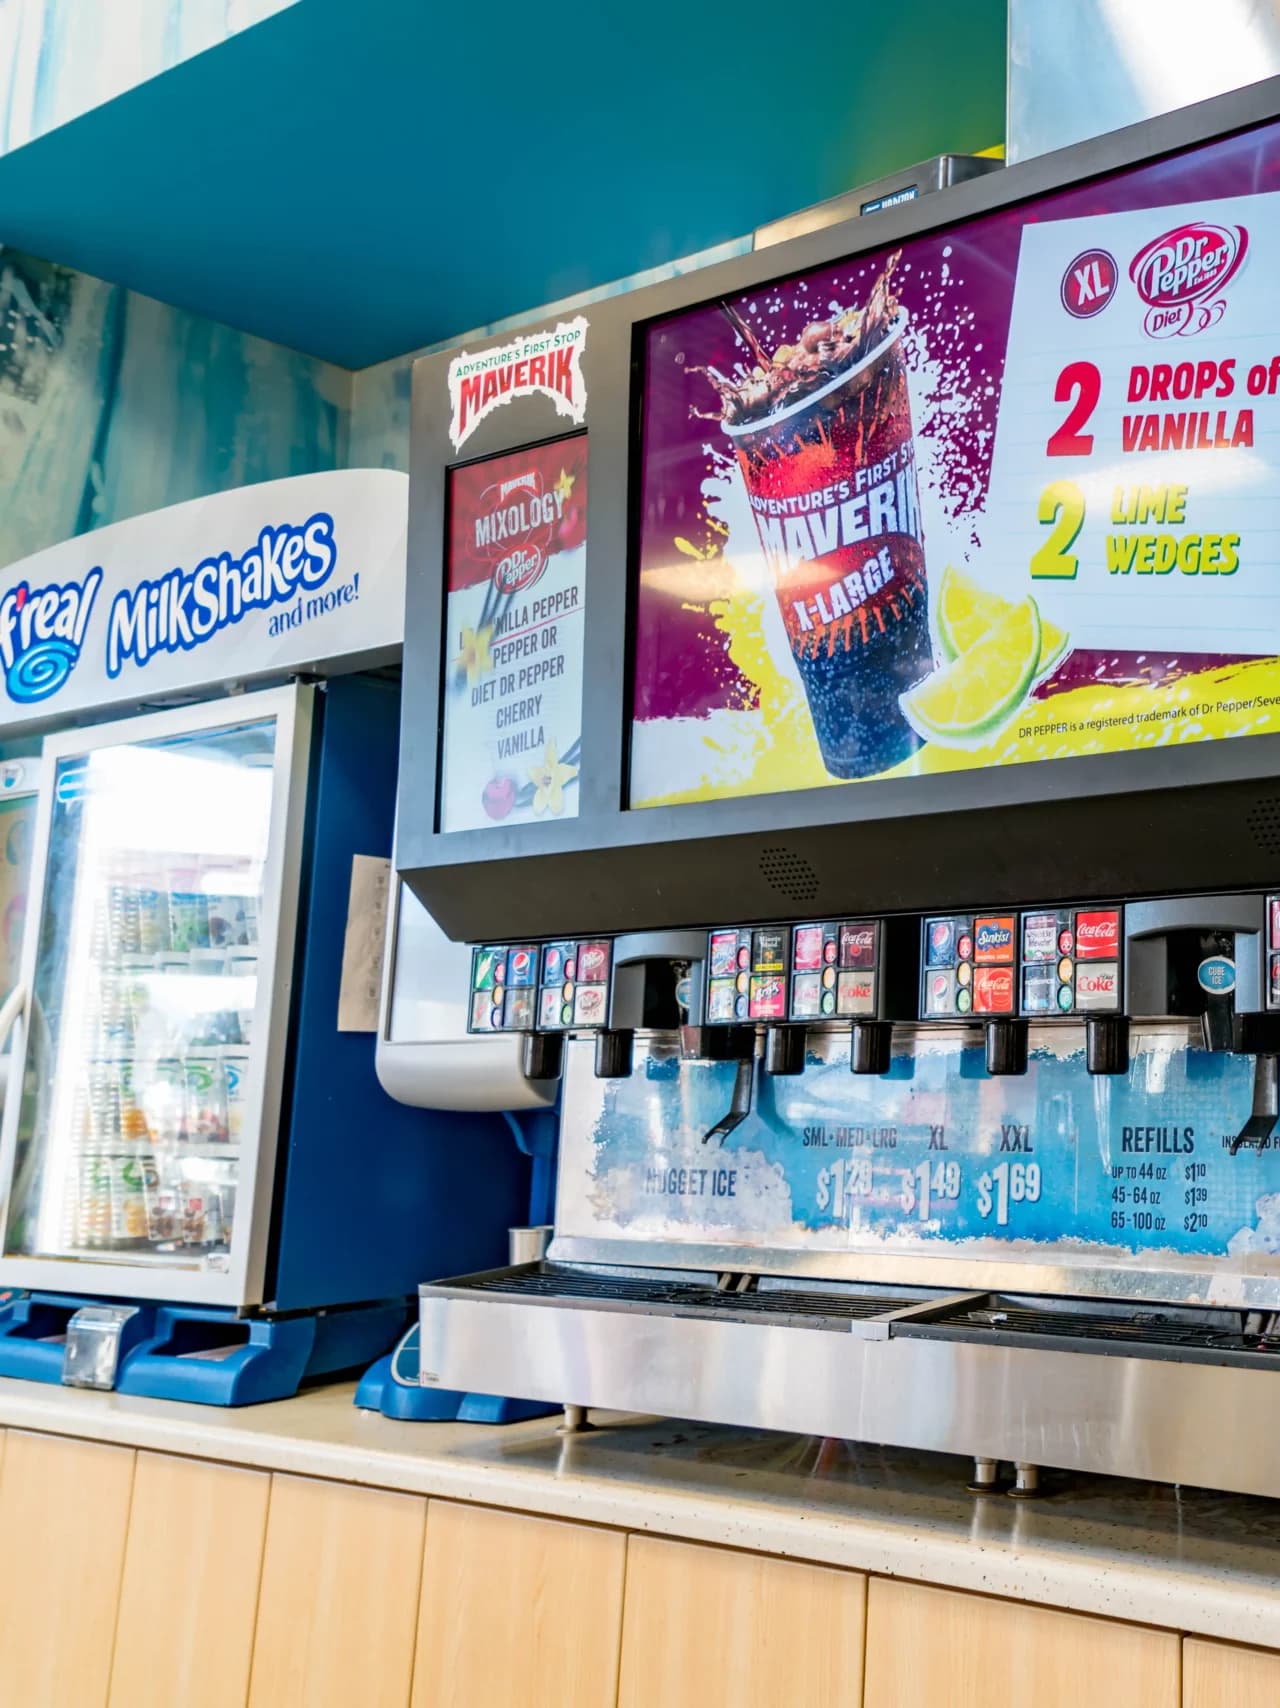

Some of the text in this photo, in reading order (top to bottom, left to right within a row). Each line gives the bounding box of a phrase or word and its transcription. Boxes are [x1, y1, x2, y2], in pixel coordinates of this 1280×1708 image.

[1175, 236, 1210, 263] Dr
[1074, 261, 1110, 306] XL
[1149, 243, 1230, 300] Pepper
[1153, 308, 1182, 332] Diet
[456, 330, 581, 378] ADVENTURE'S FIRST STOP
[458, 345, 574, 438] MAVERIK
[1127, 359, 1236, 402] DROPS
[1046, 361, 1101, 456] 2
[1122, 409, 1254, 452] VANILLA
[854, 452, 898, 493] FIRST
[475, 488, 565, 547] MIXOLOGY
[1110, 485, 1190, 525] LIME
[1029, 480, 1086, 580] 2
[498, 550, 538, 586] Dr Pepper
[1105, 533, 1241, 577] WEDGES
[269, 572, 361, 637] and more!
[533, 586, 578, 622] PEPPER
[793, 545, 895, 632] X-LARGE
[494, 637, 538, 668] PEPPER
[541, 626, 557, 649] OR
[471, 655, 564, 707] DIET DR PEPPER
[496, 694, 543, 728] CHERRY
[1019, 726, 1033, 739] DR
[1034, 721, 1068, 737] PEPPER
[1069, 721, 1077, 732] is
[1079, 722, 1084, 730] a
[1086, 713, 1134, 731] registered
[1136, 707, 1187, 723] trademark
[1189, 703, 1199, 716] of
[1202, 703, 1214, 715] Dr
[497, 726, 544, 760] VANILLA
[1078, 976, 1114, 991] Coke
[1208, 967, 1226, 976] CUBE
[928, 1125, 949, 1151] XL
[1000, 1124, 1033, 1153] XXL
[1122, 1126, 1194, 1154] REFILLS
[711, 1169, 737, 1197] ICE
[1112, 1166, 1122, 1179] UP
[1126, 1166, 1136, 1179] TO
[1139, 1162, 1153, 1180] 44
[1112, 1186, 1147, 1204] 45-64
[1111, 1211, 1152, 1230] 65-100
